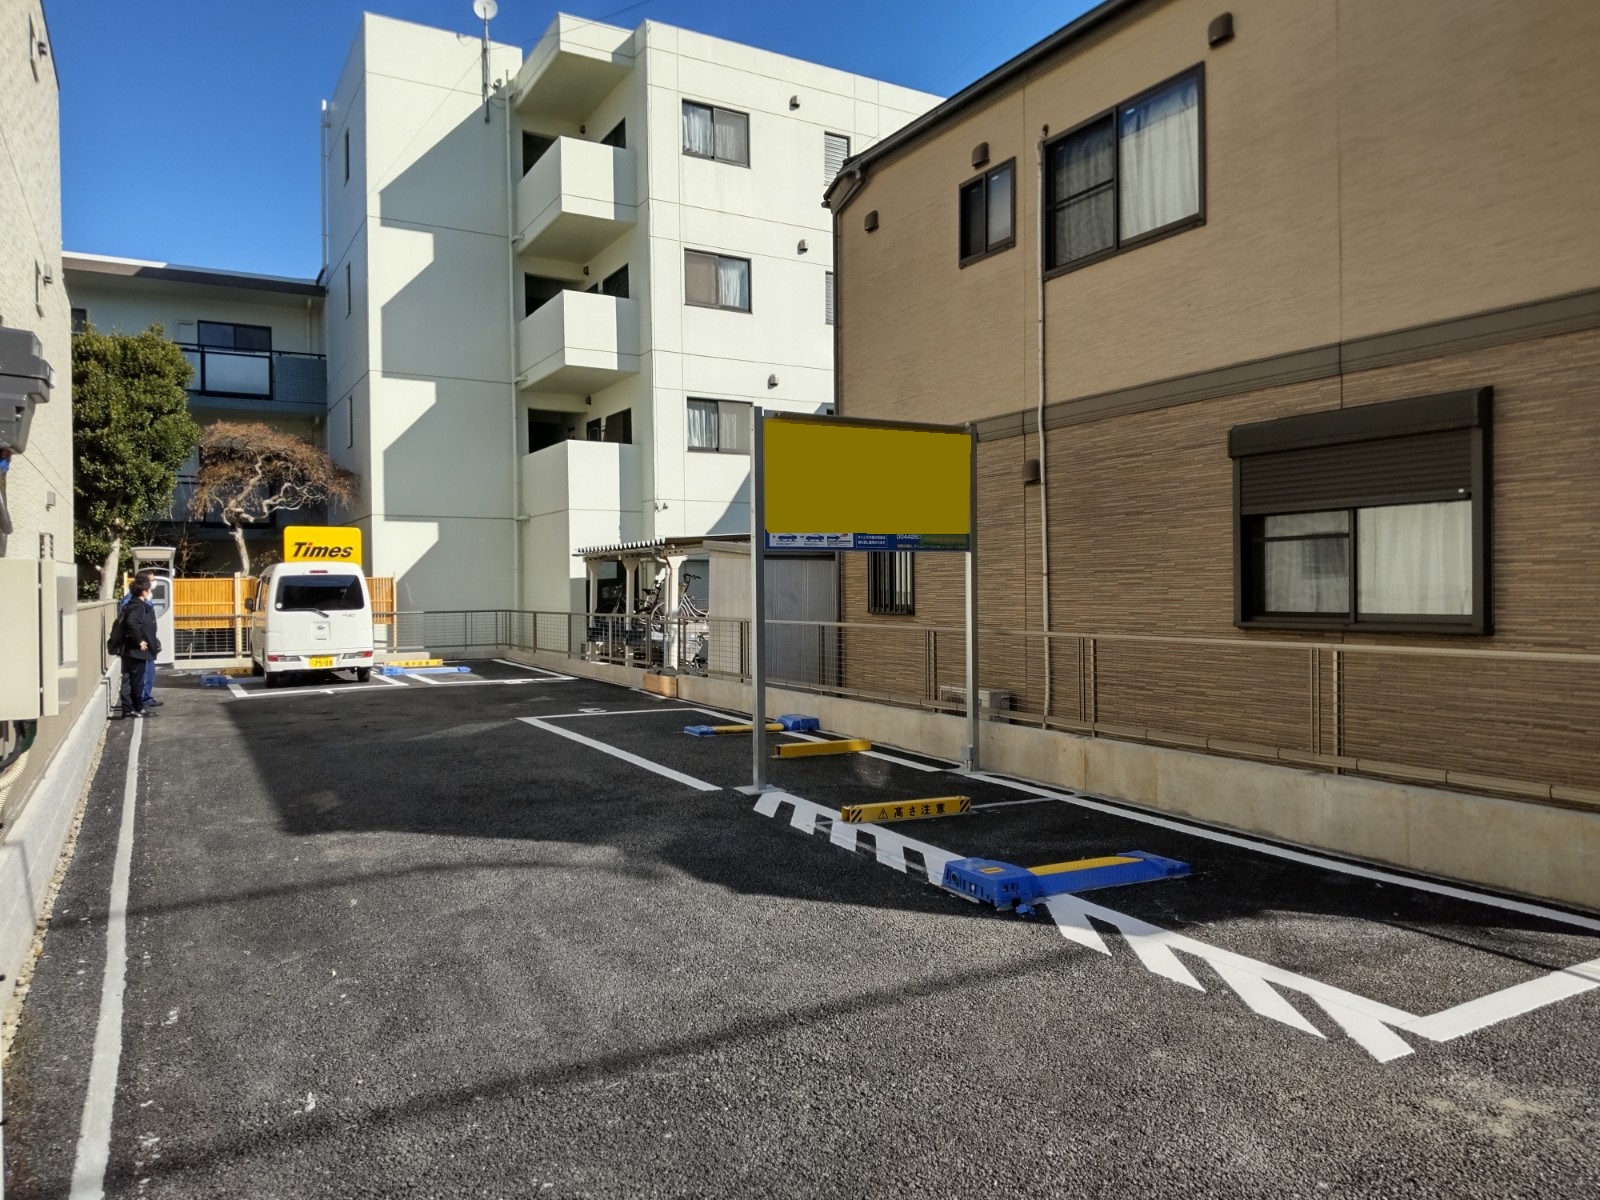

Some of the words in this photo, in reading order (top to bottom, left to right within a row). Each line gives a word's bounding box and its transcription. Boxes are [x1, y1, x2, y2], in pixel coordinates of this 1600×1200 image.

[293, 541, 354, 558] Times
[893, 802, 946, 819] 高さ注意
